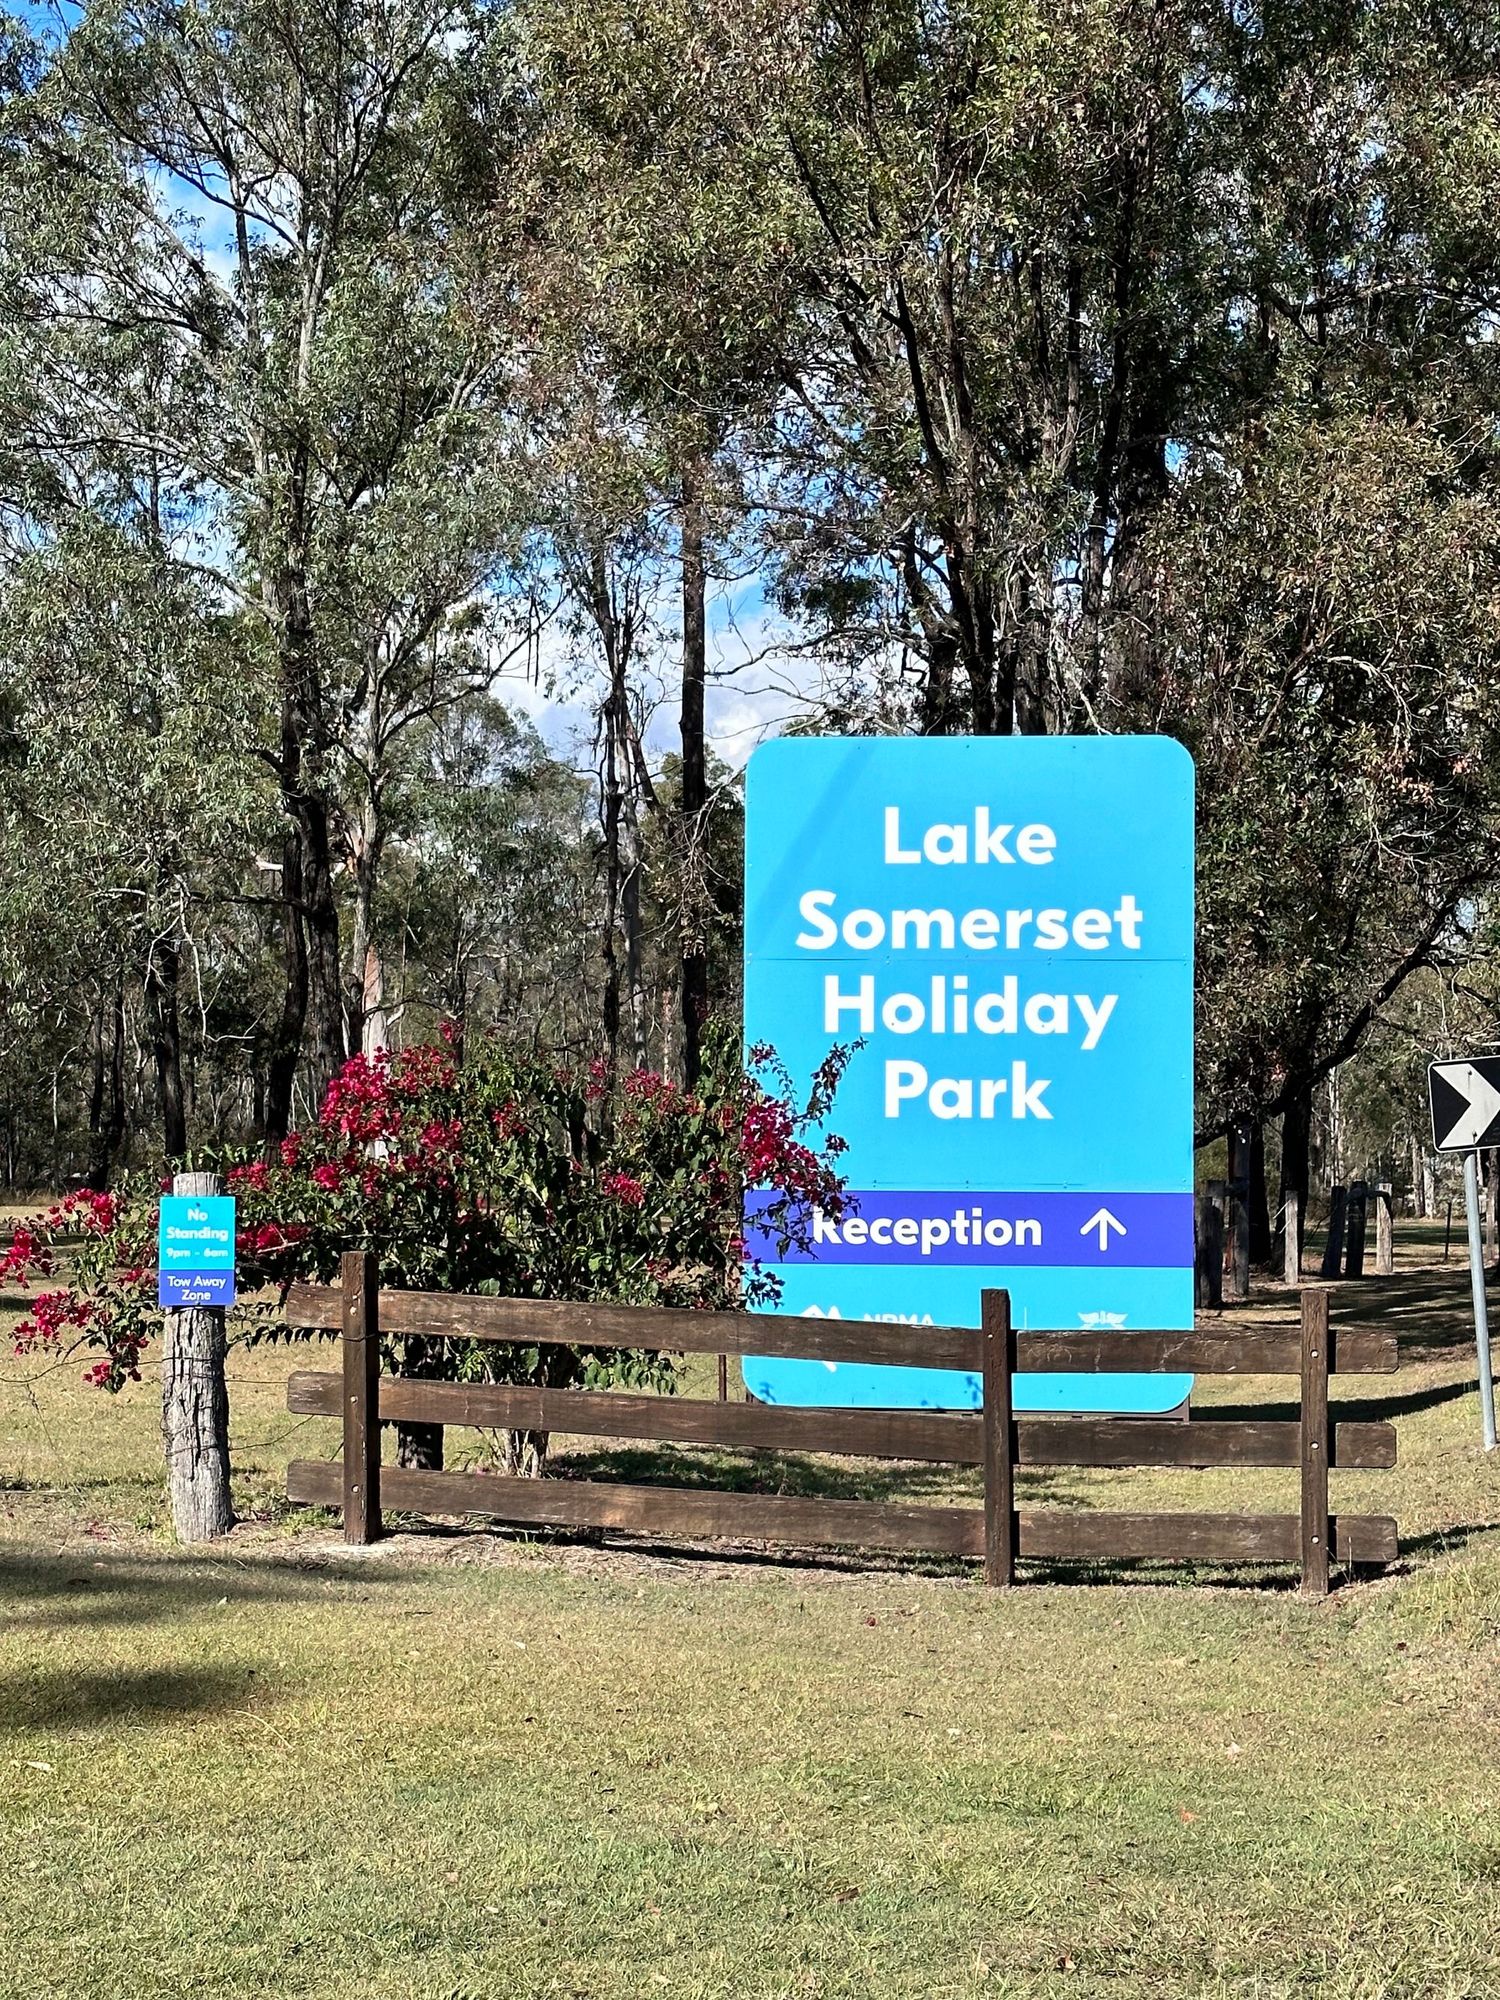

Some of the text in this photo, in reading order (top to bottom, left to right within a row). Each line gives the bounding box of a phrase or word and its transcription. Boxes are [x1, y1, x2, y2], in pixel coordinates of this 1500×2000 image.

[884, 806, 1057, 866] Lake
[795, 890, 1143, 951] Somerset
[824, 975, 1119, 1051] Holiday
[885, 1060, 1054, 1120] Park
[187, 1208, 209, 1222] No
[812, 1206, 1042, 1255] Reception
[166, 1227, 229, 1243] Standing
[166, 1247, 191, 1259] 9pm
[203, 1247, 229, 1258] 6am
[167, 1275, 226, 1290] Tow Away
[181, 1289, 212, 1302] Zone
